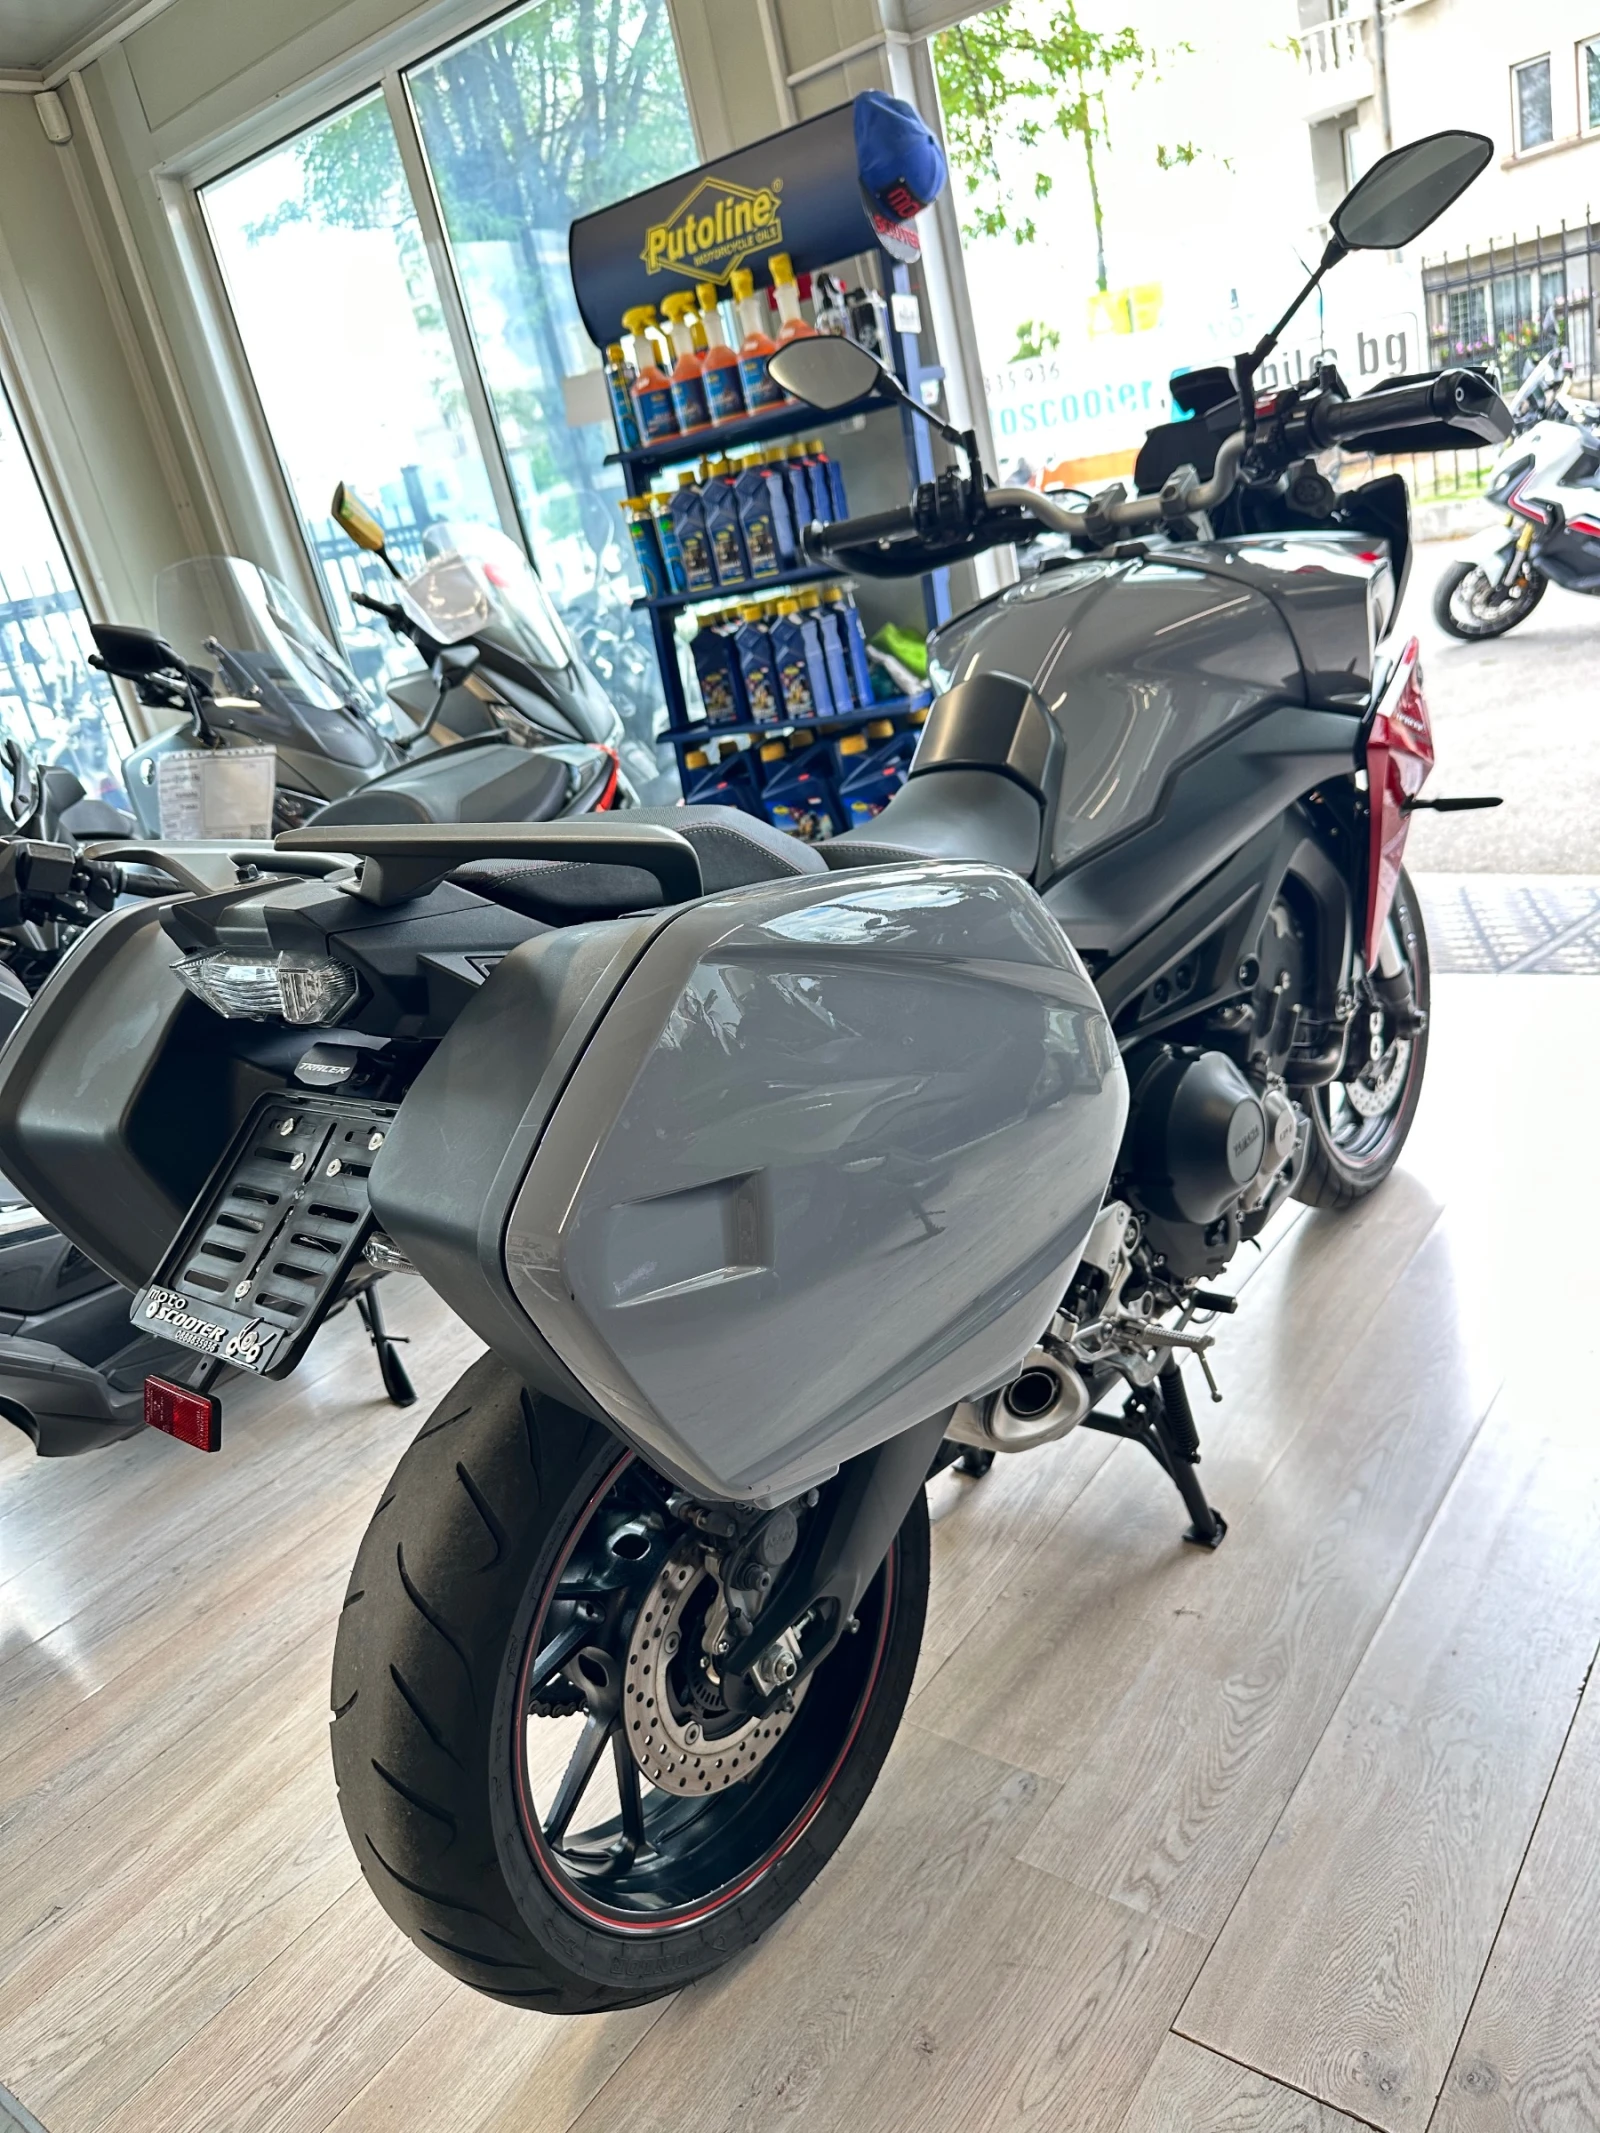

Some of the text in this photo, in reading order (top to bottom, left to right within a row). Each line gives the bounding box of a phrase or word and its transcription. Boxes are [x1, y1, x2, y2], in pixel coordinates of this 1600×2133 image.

[650, 194, 772, 268] Putoline
[693, 226, 778, 267] MOTORCYCLE OILS
[298, 1062, 351, 1075] TRACER
[155, 1306, 227, 1342] SCOOTER
